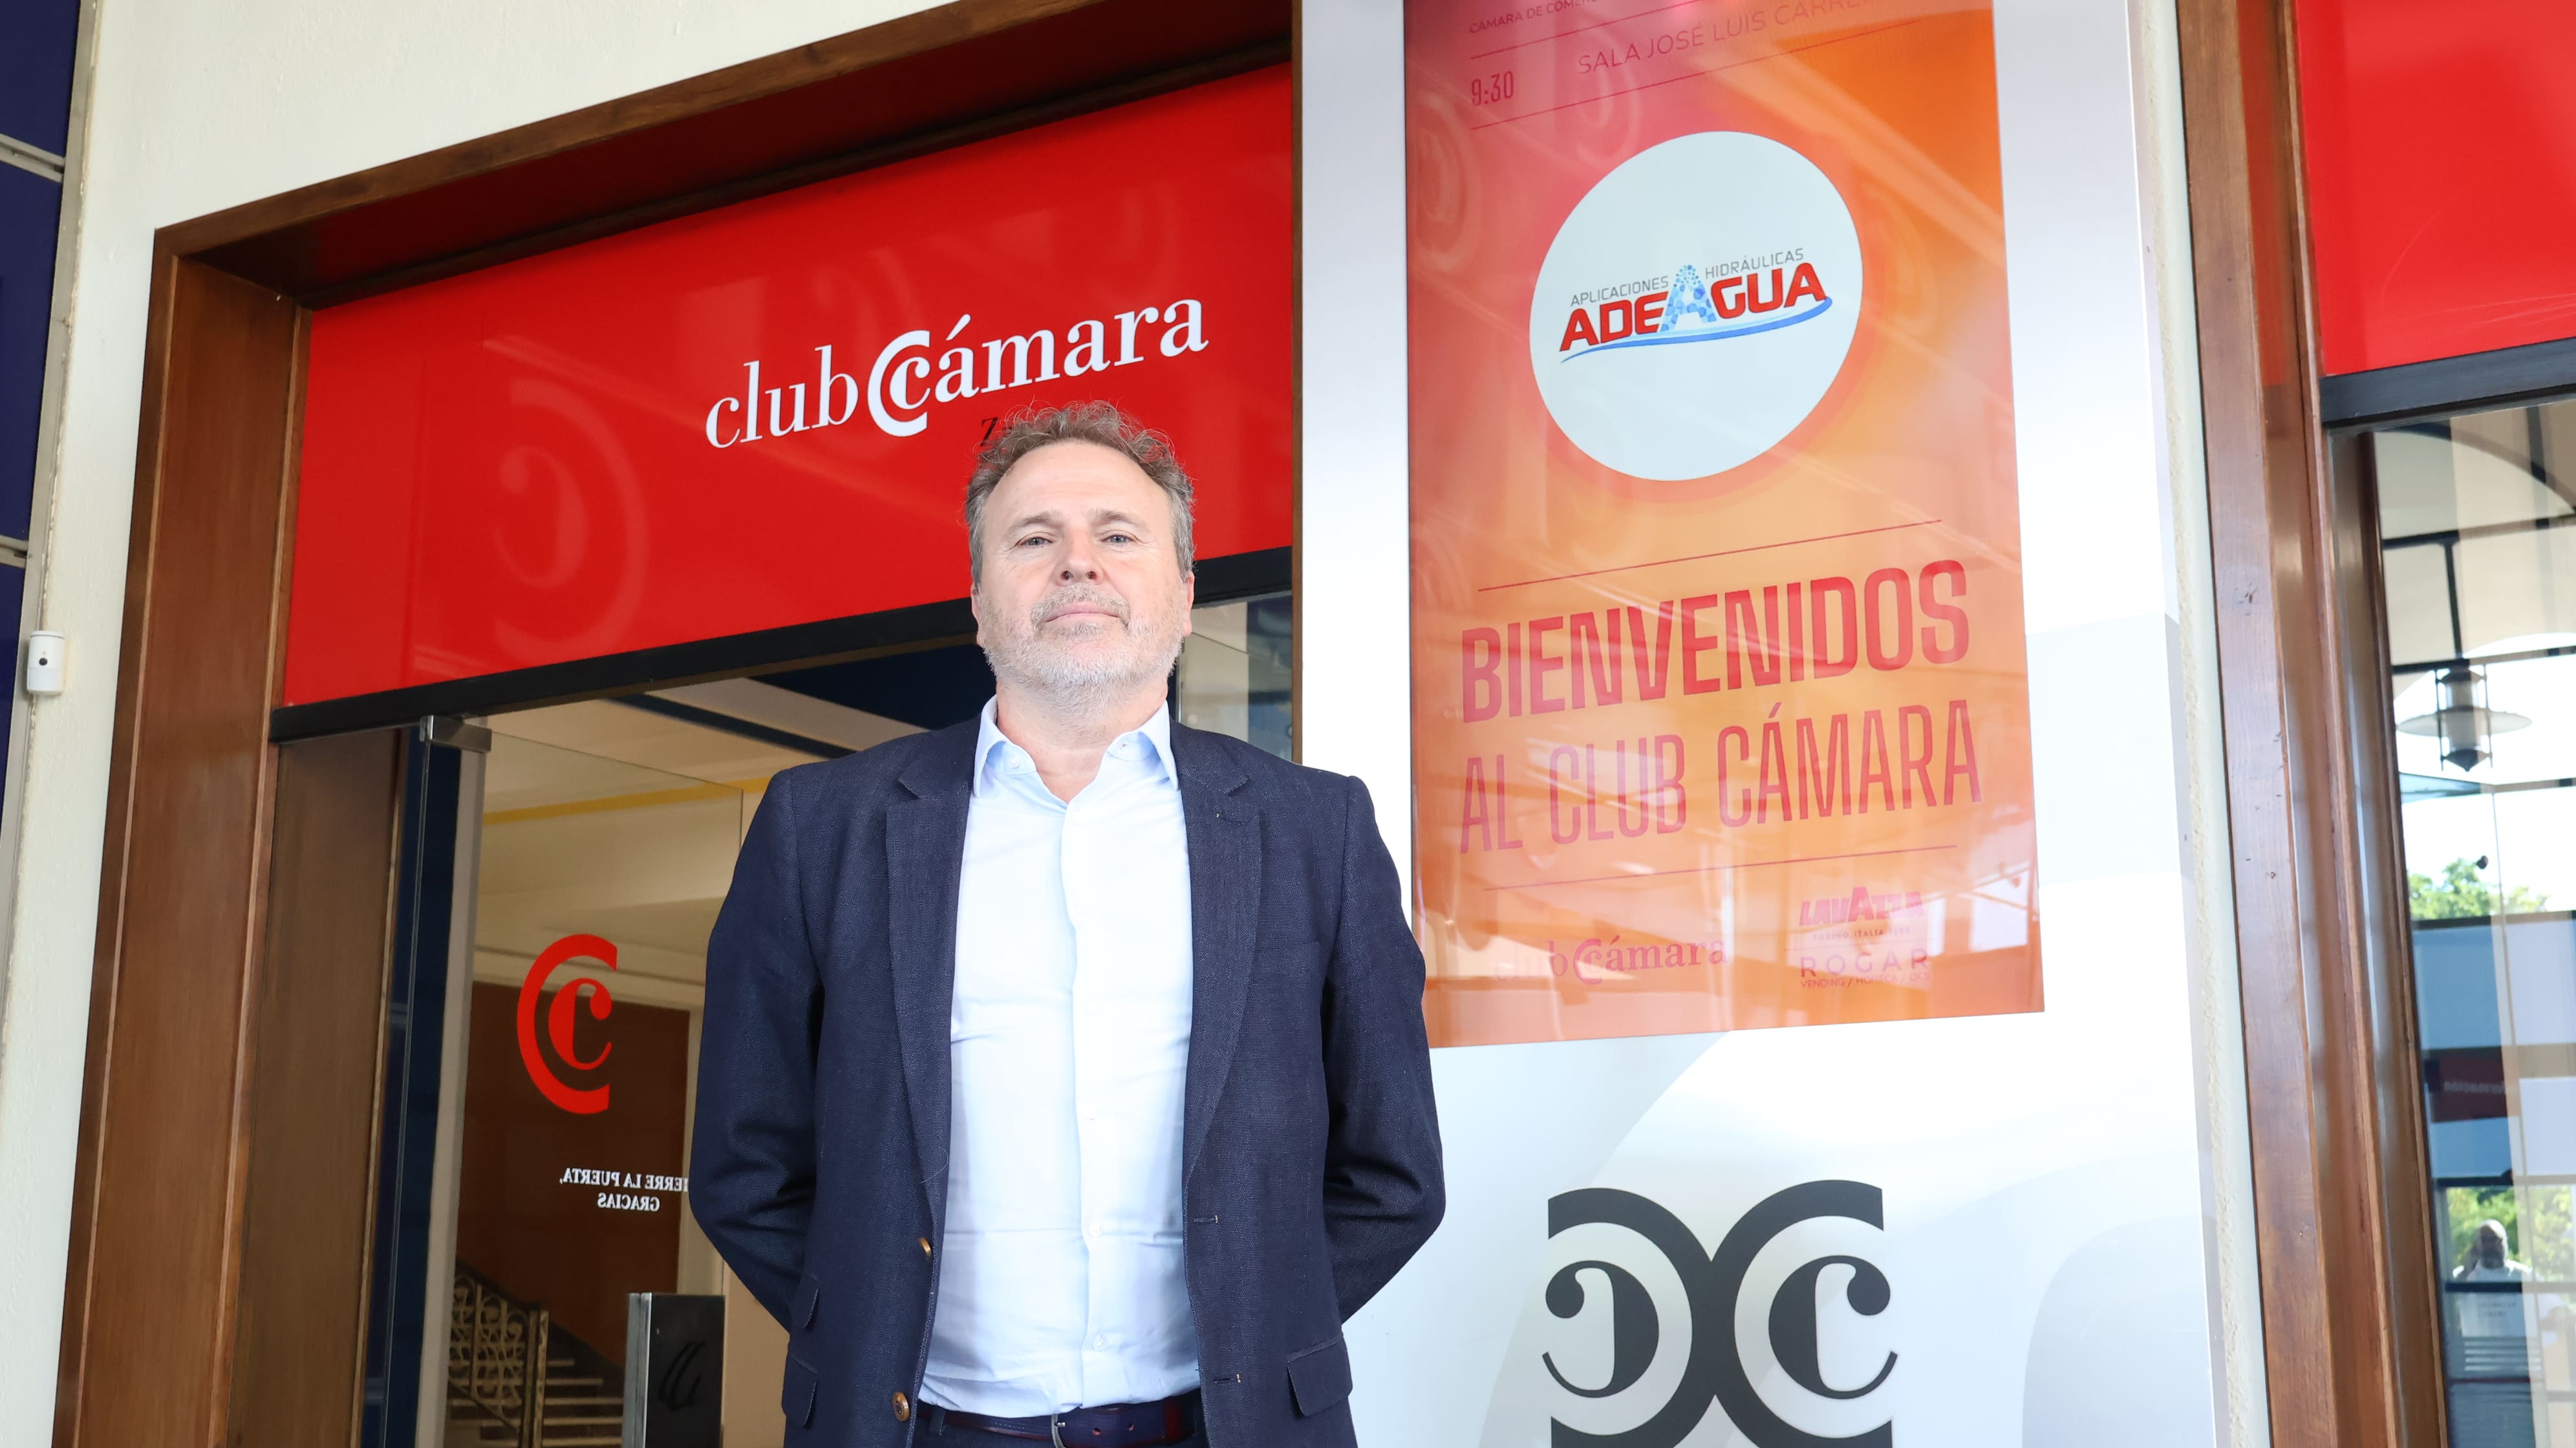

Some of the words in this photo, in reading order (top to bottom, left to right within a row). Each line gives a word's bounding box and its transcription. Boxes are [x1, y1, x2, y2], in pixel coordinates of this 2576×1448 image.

[1527, 5, 1542, 19] DE
[1578, 43, 1641, 75] SALA
[1647, 21, 1704, 59] JOSÉ
[1713, 11, 1766, 42] LUIS
[1471, 70, 1514, 107] 9:30
[1559, 261, 1828, 352] ADEAGUA
[1570, 275, 1669, 308] APLICACIONES
[1704, 248, 1804, 280] HIDRÁULICAS
[1460, 559, 1970, 724] BIENVENIDOS
[1459, 751, 1523, 855] AL
[1549, 732, 1688, 845] CLUB
[1715, 698, 1983, 827] CÁMARA
[1800, 948, 1929, 978] ROGAR
[1800, 978, 1845, 988] VENDING
